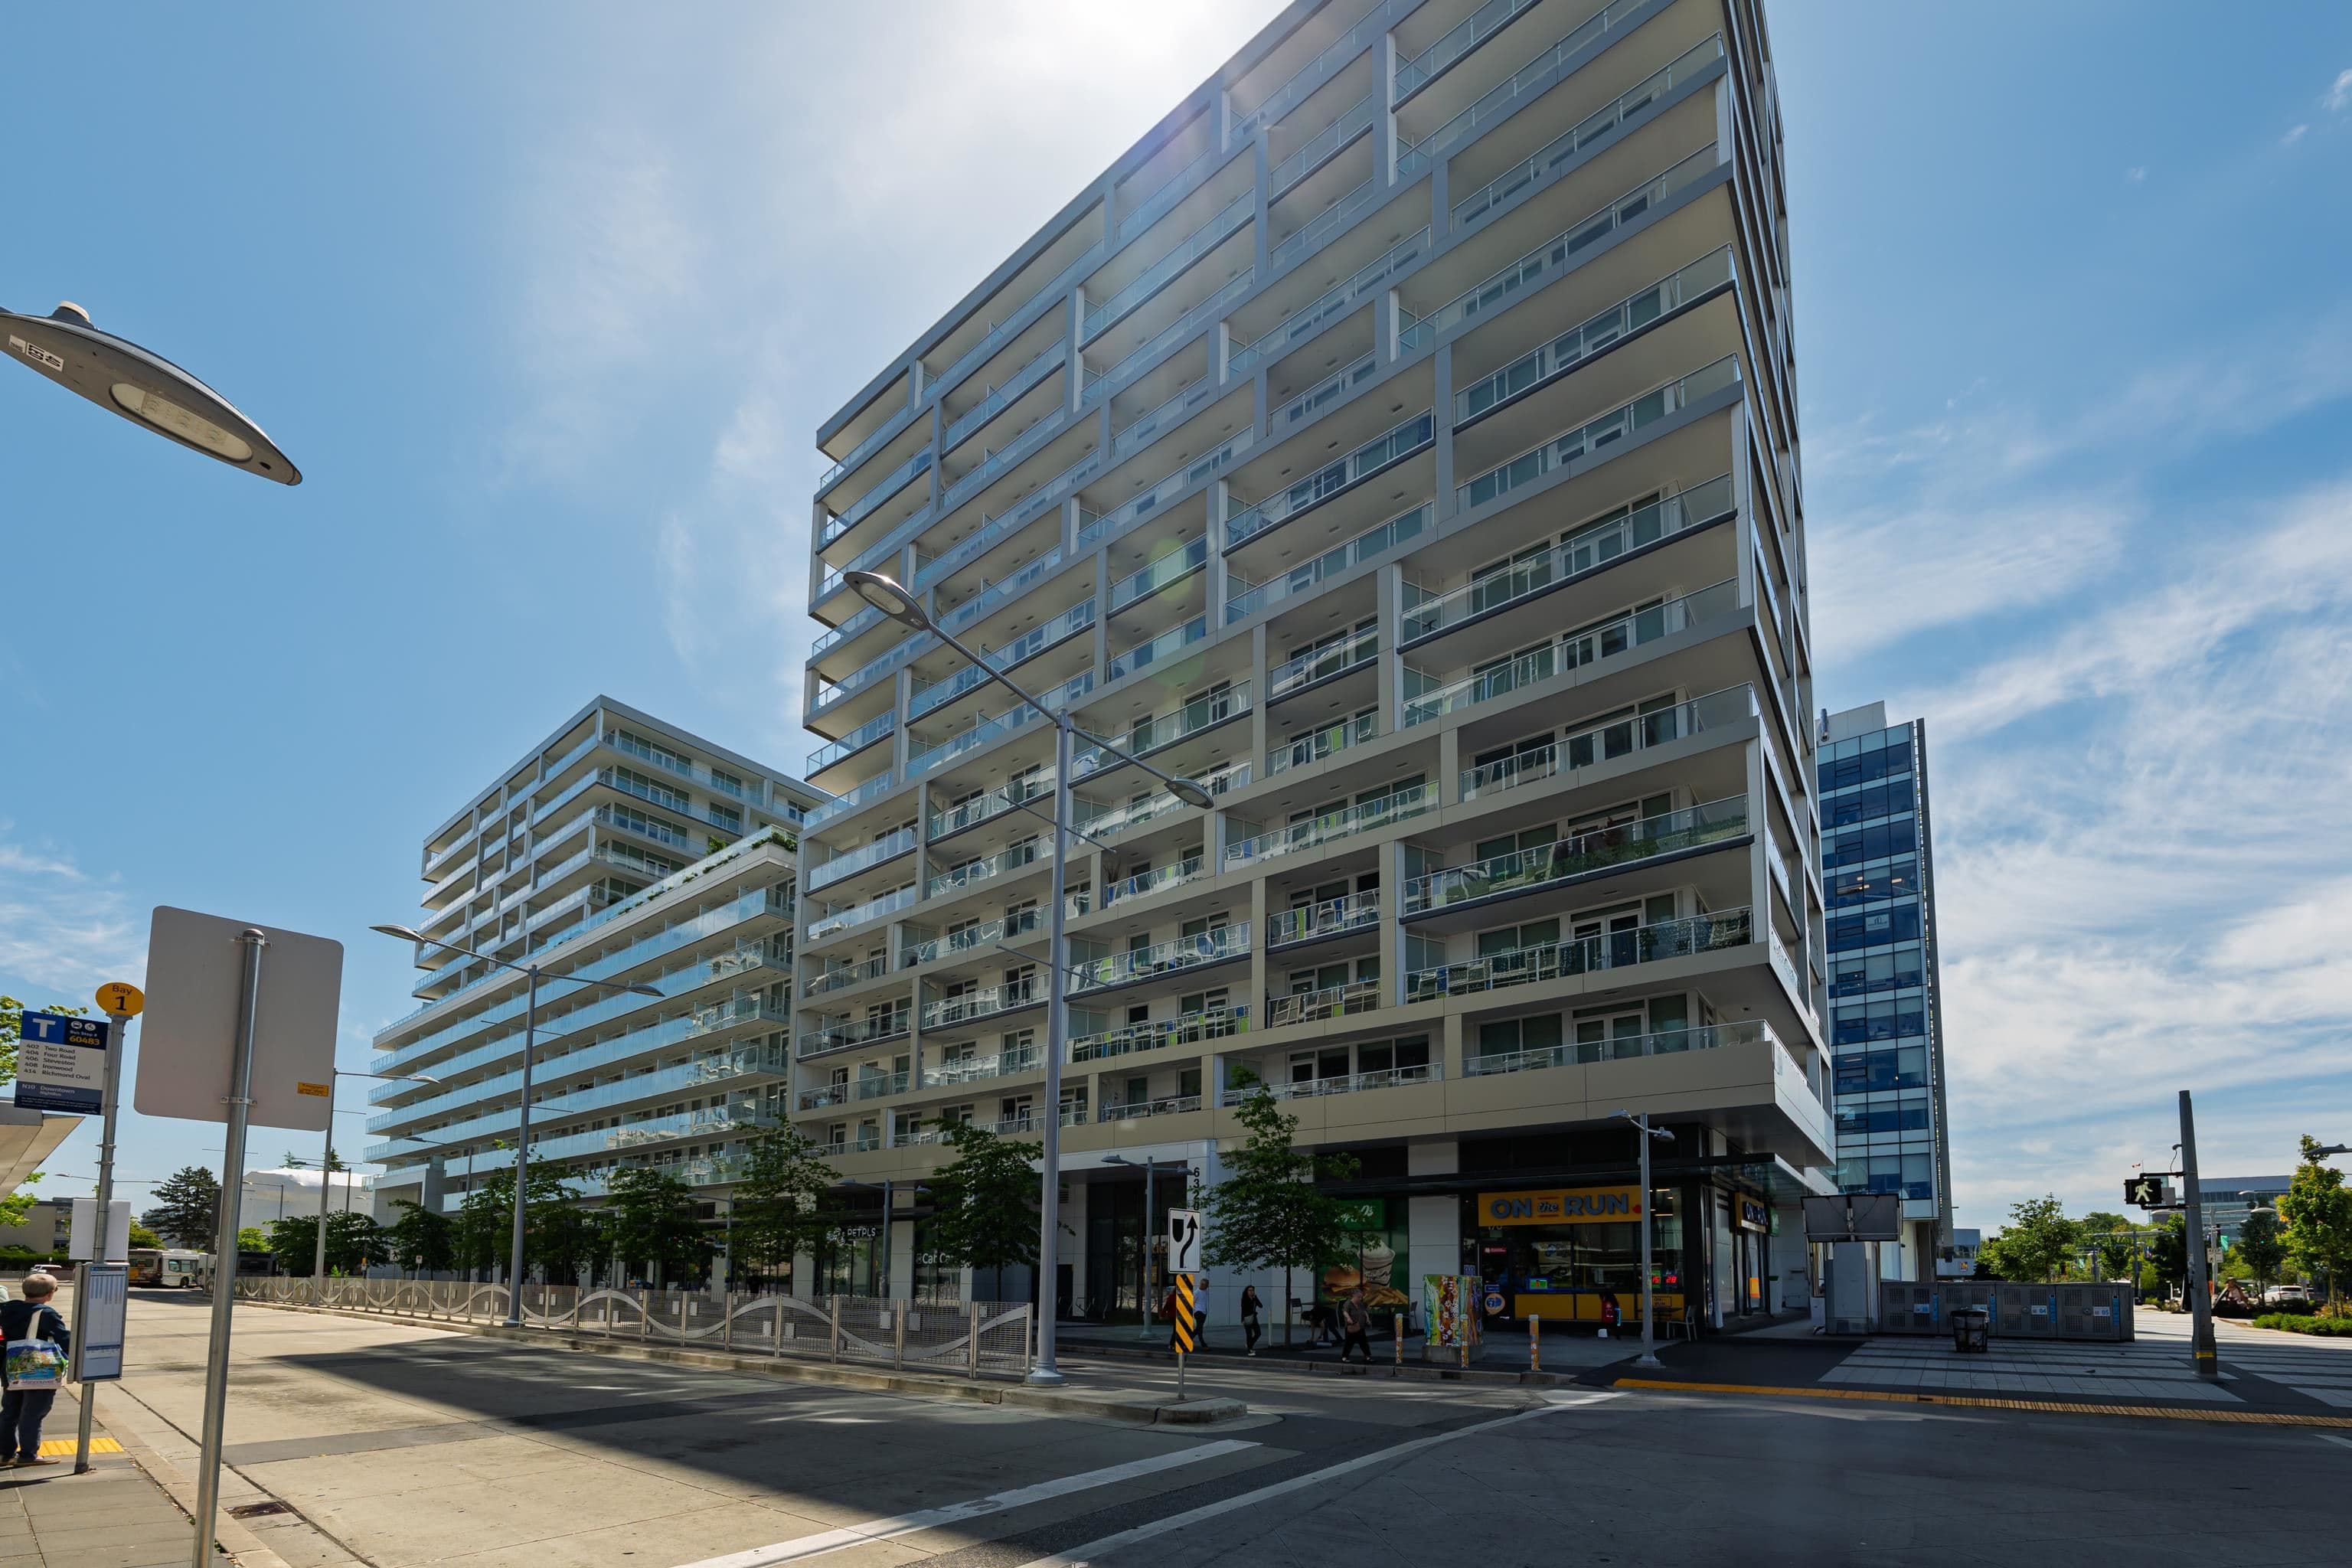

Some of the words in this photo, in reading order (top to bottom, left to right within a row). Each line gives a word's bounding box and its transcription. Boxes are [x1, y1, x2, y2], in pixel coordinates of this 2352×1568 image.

[113, 985, 132, 995] Bay
[116, 996, 126, 1011] 1
[32, 1018, 56, 1037] T
[70, 1036, 100, 1045] 60483
[1491, 1197, 1532, 1219] ON
[1537, 1201, 1560, 1213] the
[1564, 1194, 1628, 1216] RUN
